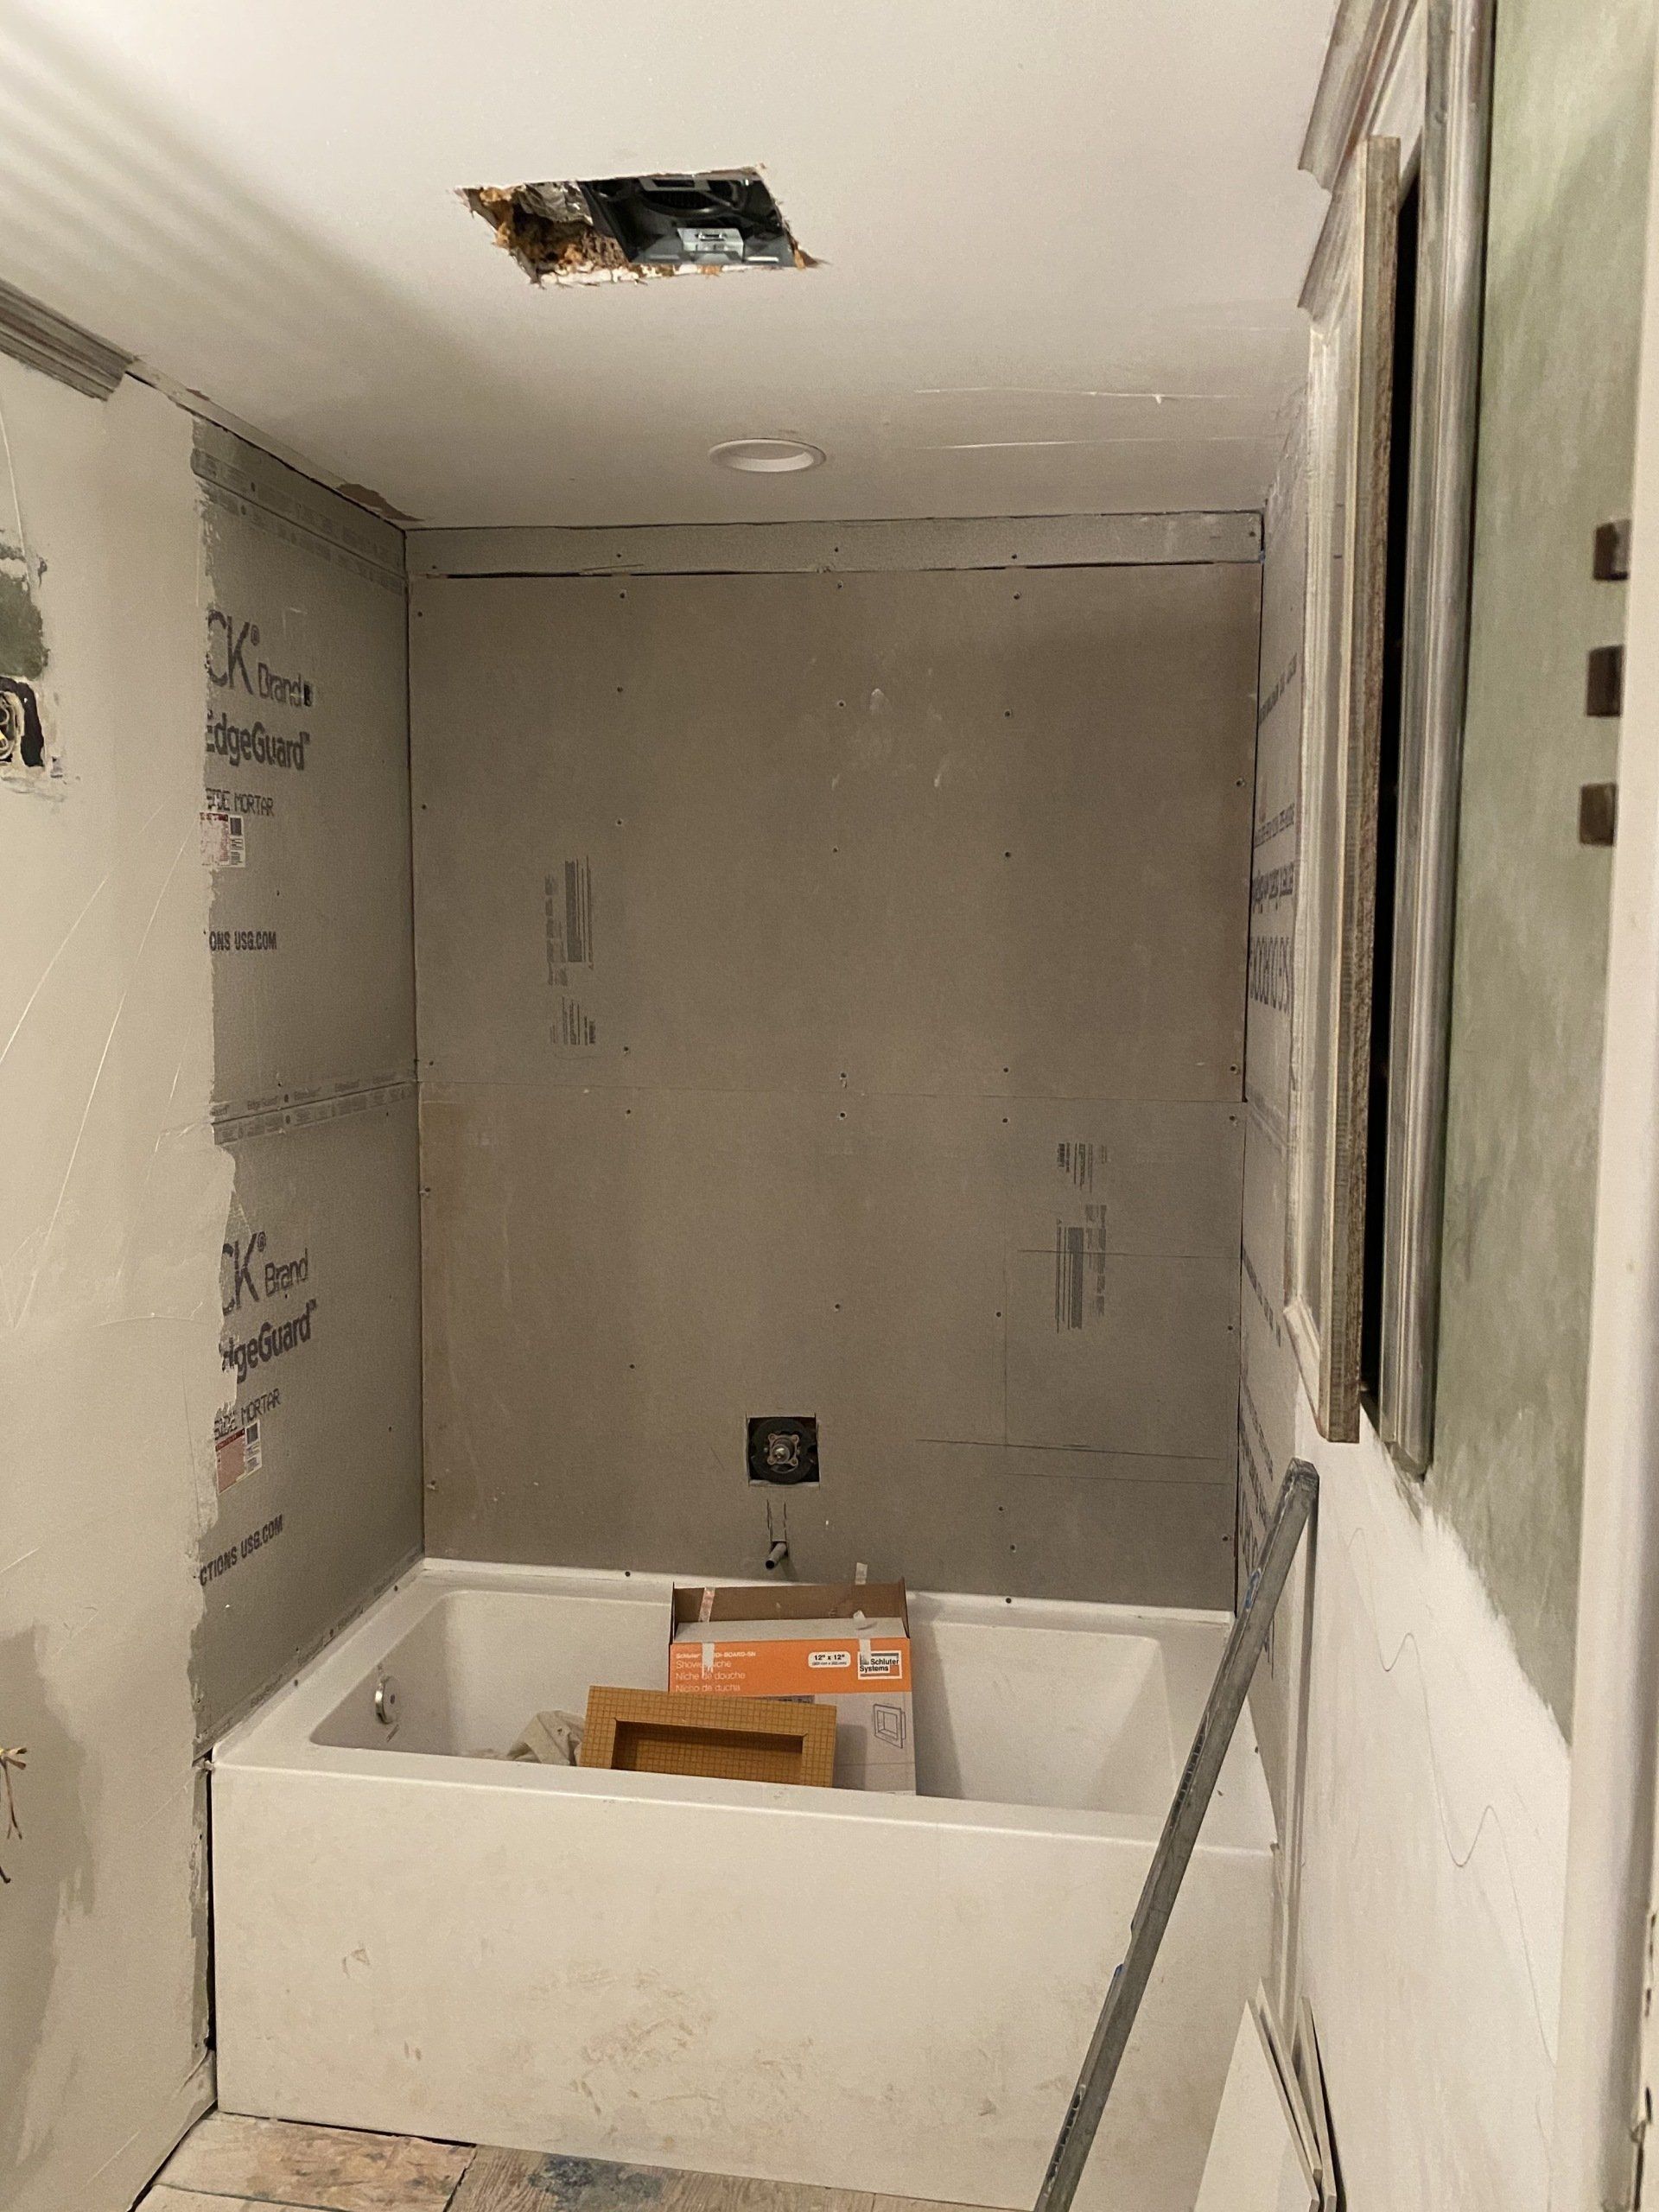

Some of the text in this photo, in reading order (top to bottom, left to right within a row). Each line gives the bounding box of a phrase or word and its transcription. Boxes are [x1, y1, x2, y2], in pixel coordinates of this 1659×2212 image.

[234, 792, 275, 817] MORTAR
[234, 931, 276, 950] USG.COM
[265, 1247, 308, 1297] Brand
[241, 1388, 281, 1427] MORTAR
[200, 1514, 283, 1586] CTIONS USG.COM
